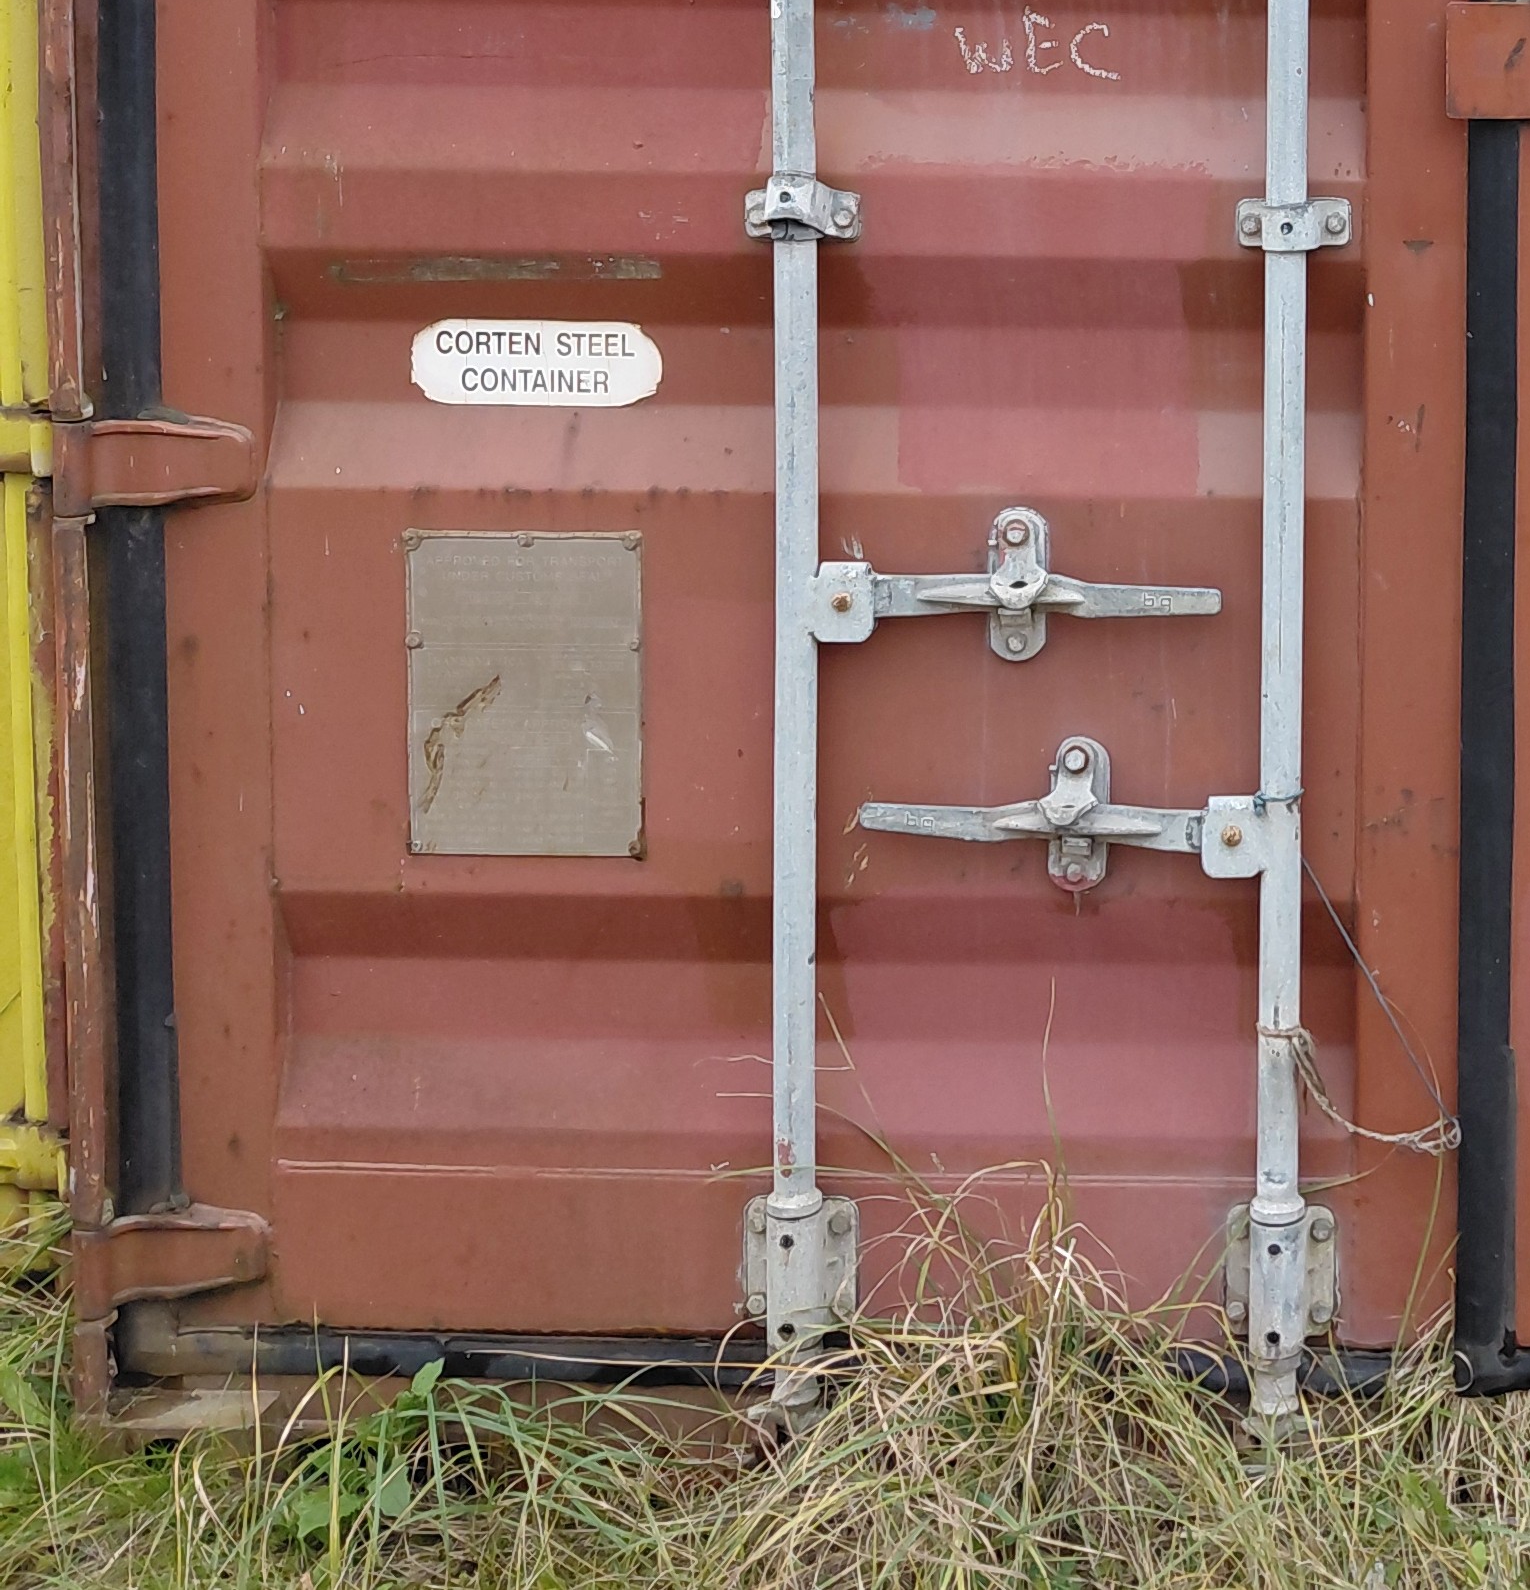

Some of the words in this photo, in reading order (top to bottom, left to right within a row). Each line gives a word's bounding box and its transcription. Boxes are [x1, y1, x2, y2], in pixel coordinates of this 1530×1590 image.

[953, 4, 1122, 81] WEC
[434, 330, 542, 358] CORTEN
[555, 332, 636, 359] STEEL
[460, 366, 610, 395] CONTAINER
